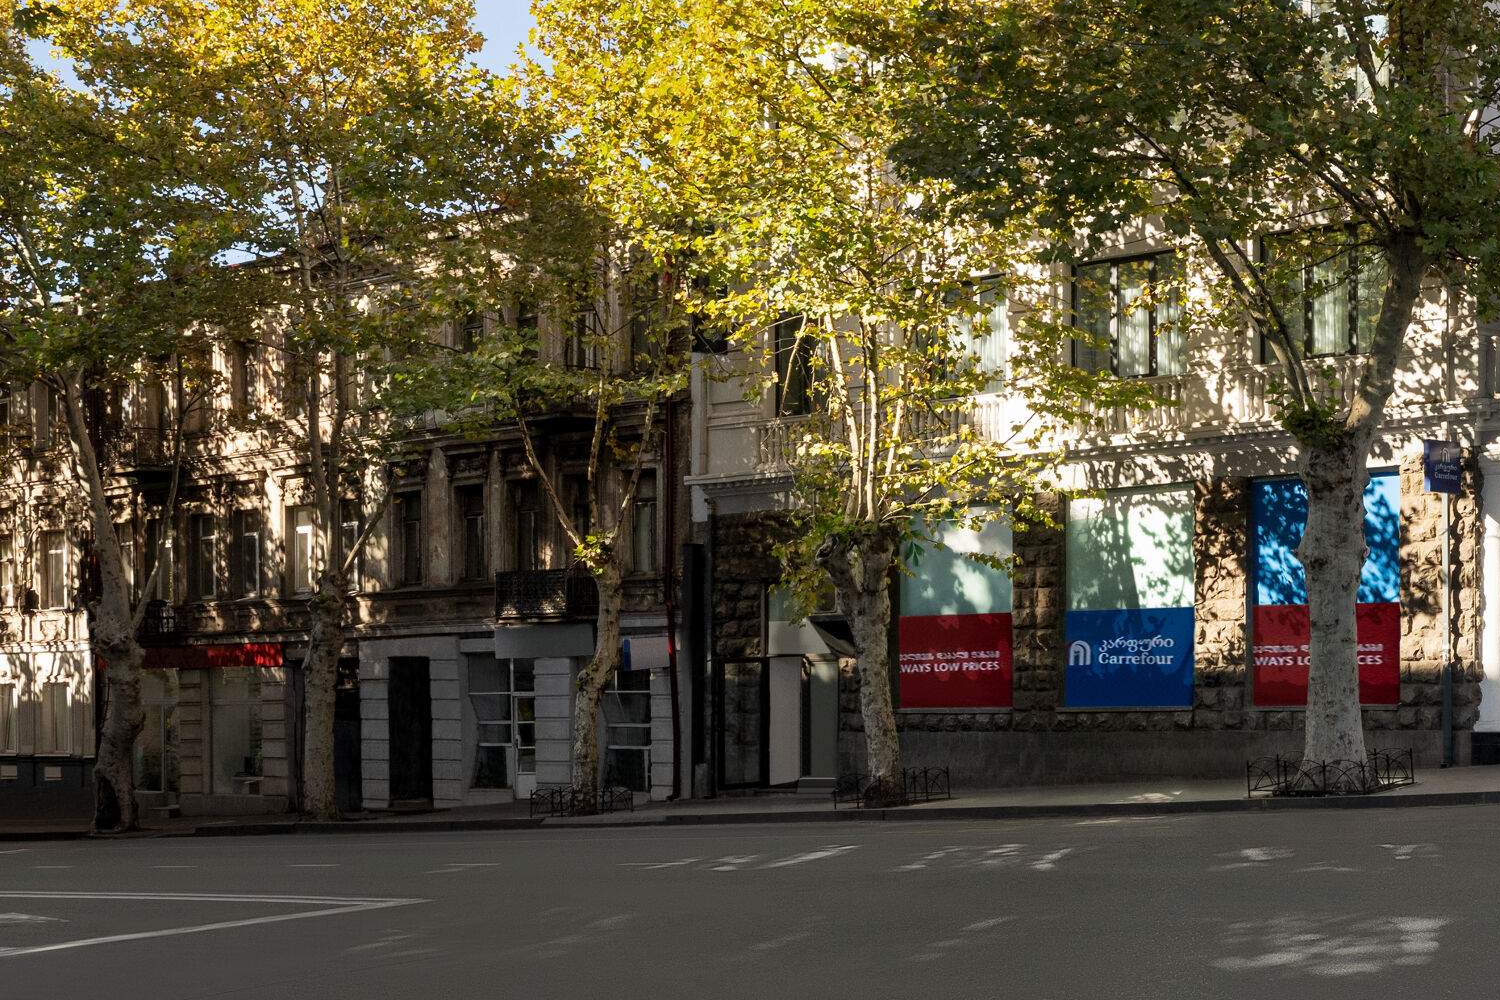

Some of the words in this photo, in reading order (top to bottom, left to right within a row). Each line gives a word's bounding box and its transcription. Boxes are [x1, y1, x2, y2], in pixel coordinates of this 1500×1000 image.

[1098, 652, 1174, 665] Carrefour
[1297, 656, 1312, 666] LO
[934, 662, 960, 672] LOW
[962, 661, 1000, 671] PRICES
